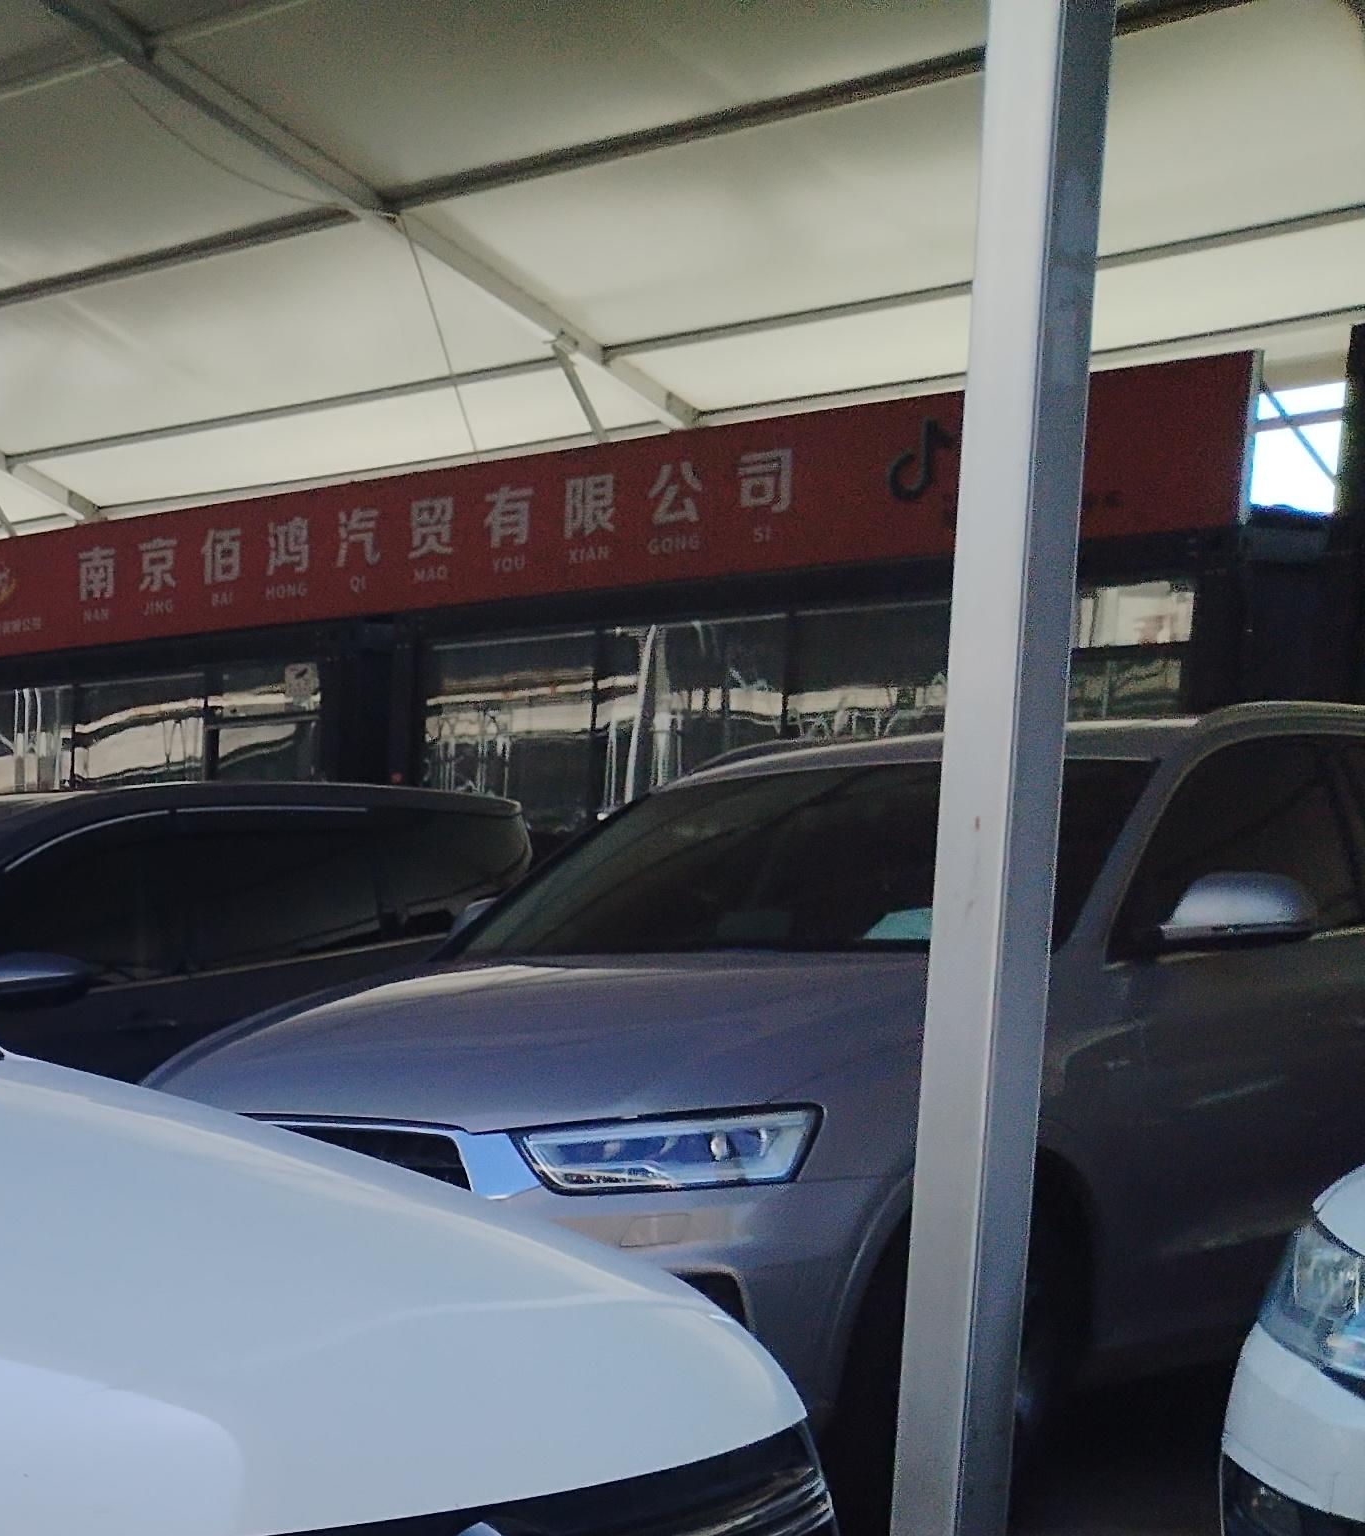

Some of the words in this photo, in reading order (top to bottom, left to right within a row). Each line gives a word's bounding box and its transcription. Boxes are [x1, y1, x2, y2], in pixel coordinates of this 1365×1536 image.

[77, 447, 794, 602] 南京佰鸿汽贸有限公司
[83, 608, 110, 623] NAN
[143, 599, 174, 616] JING
[211, 592, 233, 607] BAI
[265, 583, 308, 600] HONG
[350, 574, 366, 593] QI
[413, 564, 449, 582] MAO
[491, 554, 526, 574] YOU
[569, 546, 609, 563] XIAN
[649, 534, 701, 555] GONG
[753, 525, 773, 543] SI
